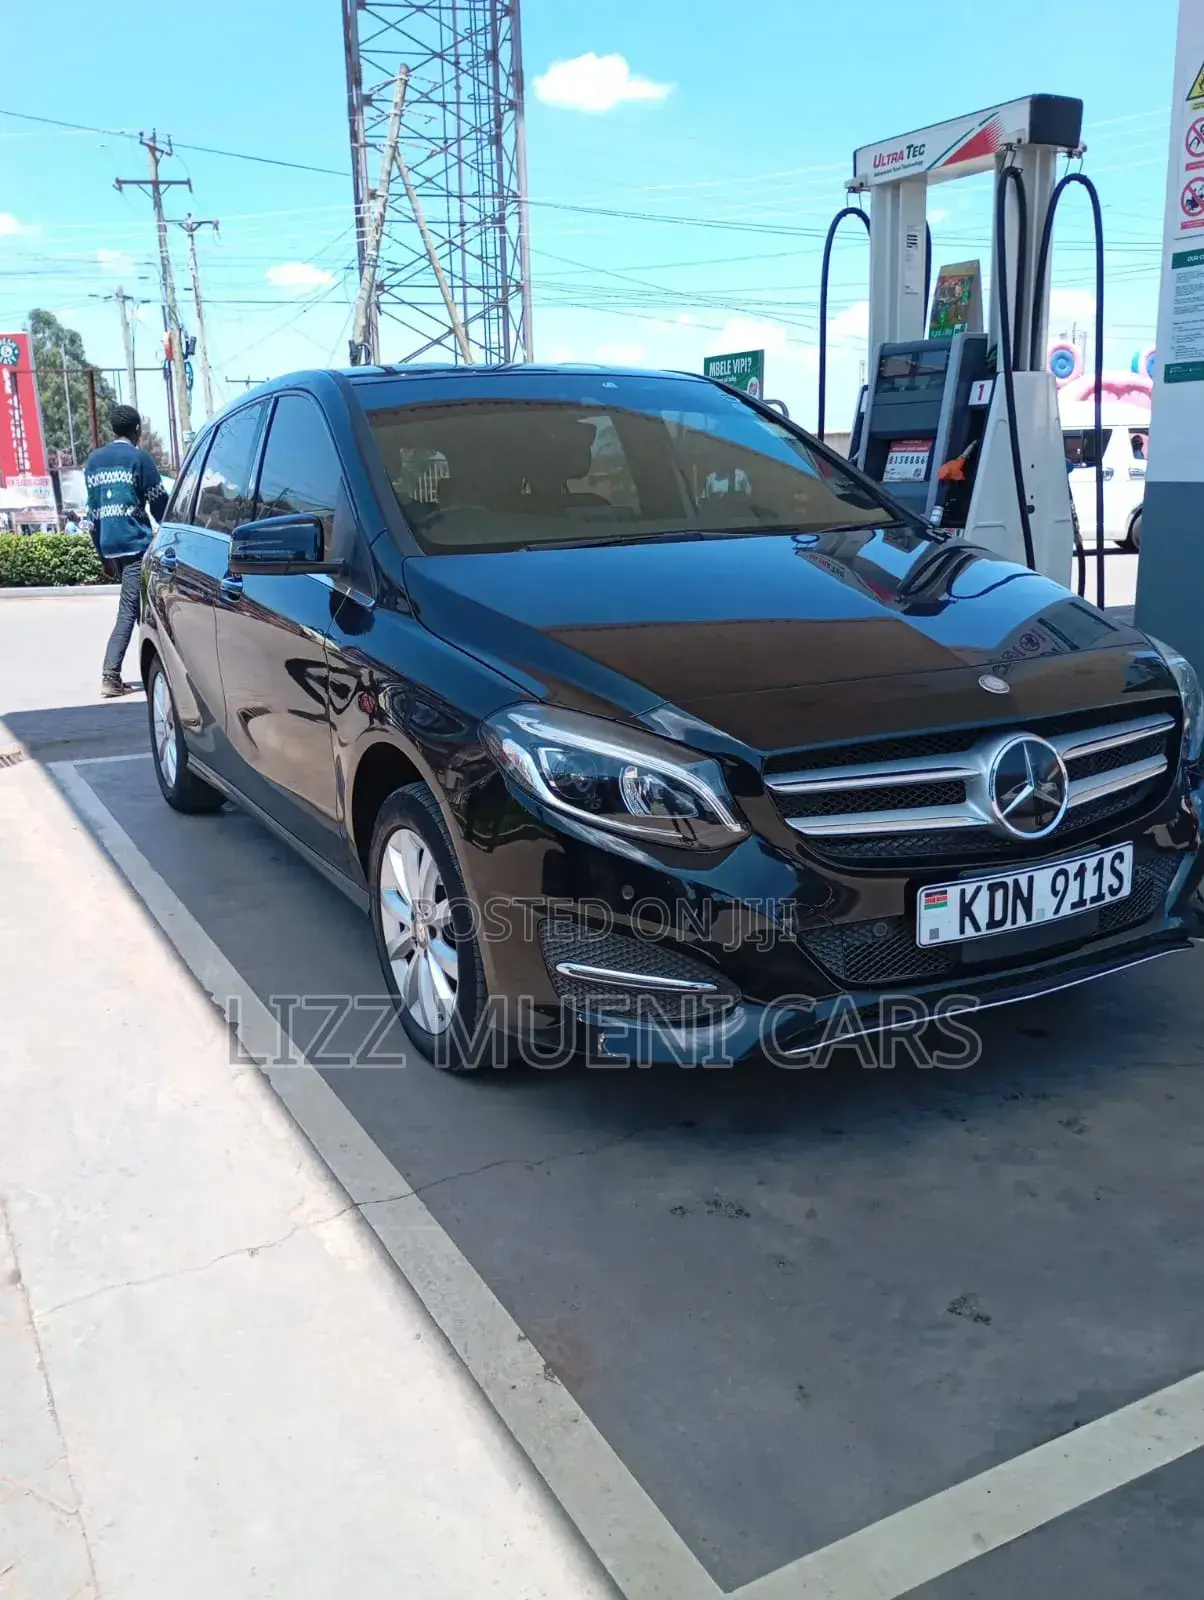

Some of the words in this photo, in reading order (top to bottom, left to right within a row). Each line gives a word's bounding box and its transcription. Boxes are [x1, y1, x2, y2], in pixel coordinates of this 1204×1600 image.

[873, 150, 904, 169] ULTRA
[906, 143, 926, 160] TEC
[709, 360, 732, 377] MBELE
[733, 357, 752, 374] VIPI?
[978, 384, 985, 401] 1
[959, 874, 1035, 936] KDN
[1050, 851, 1125, 916] 911S
